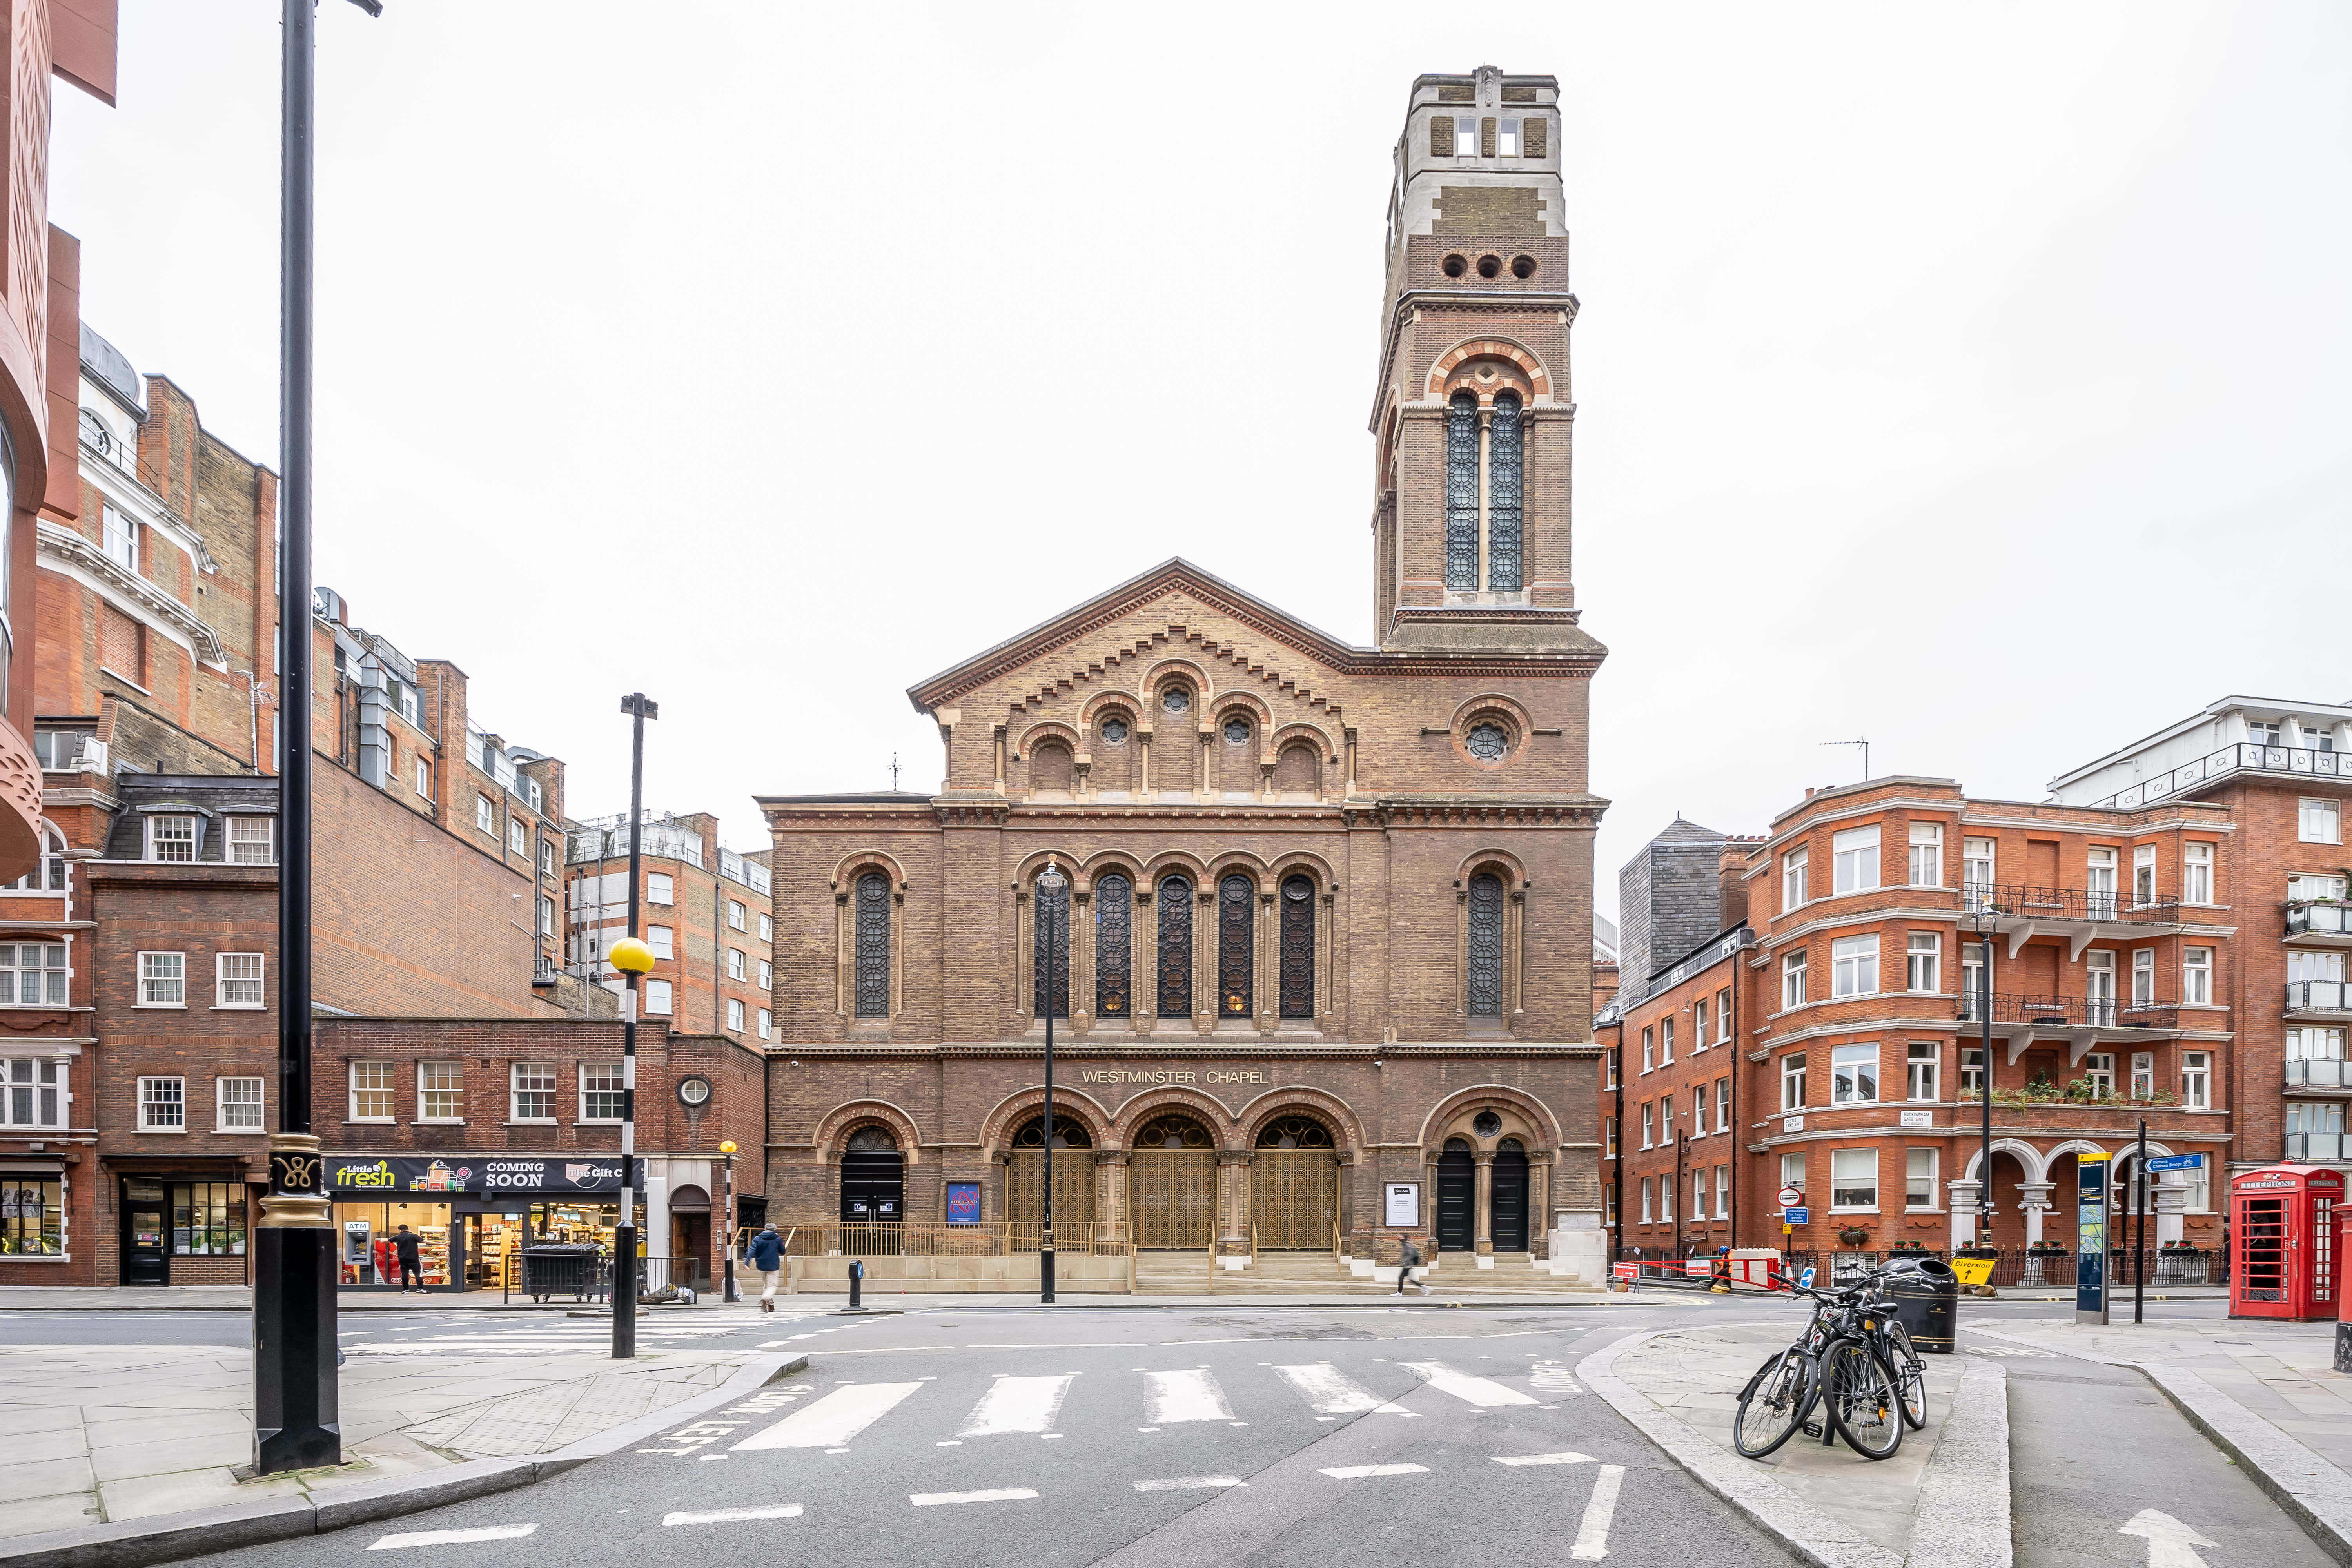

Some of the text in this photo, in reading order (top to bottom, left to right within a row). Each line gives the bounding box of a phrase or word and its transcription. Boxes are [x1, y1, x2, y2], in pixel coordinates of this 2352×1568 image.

[1082, 1071, 1269, 1083] WESTMINSTER CHAPEL
[336, 1160, 395, 1185] fresh
[486, 1163, 544, 1172] COMING
[568, 1168, 590, 1177] The
[592, 1168, 613, 1177] Gift
[486, 1174, 544, 1187] SOON
[635, 1392, 808, 1456] LOOK LEFT
